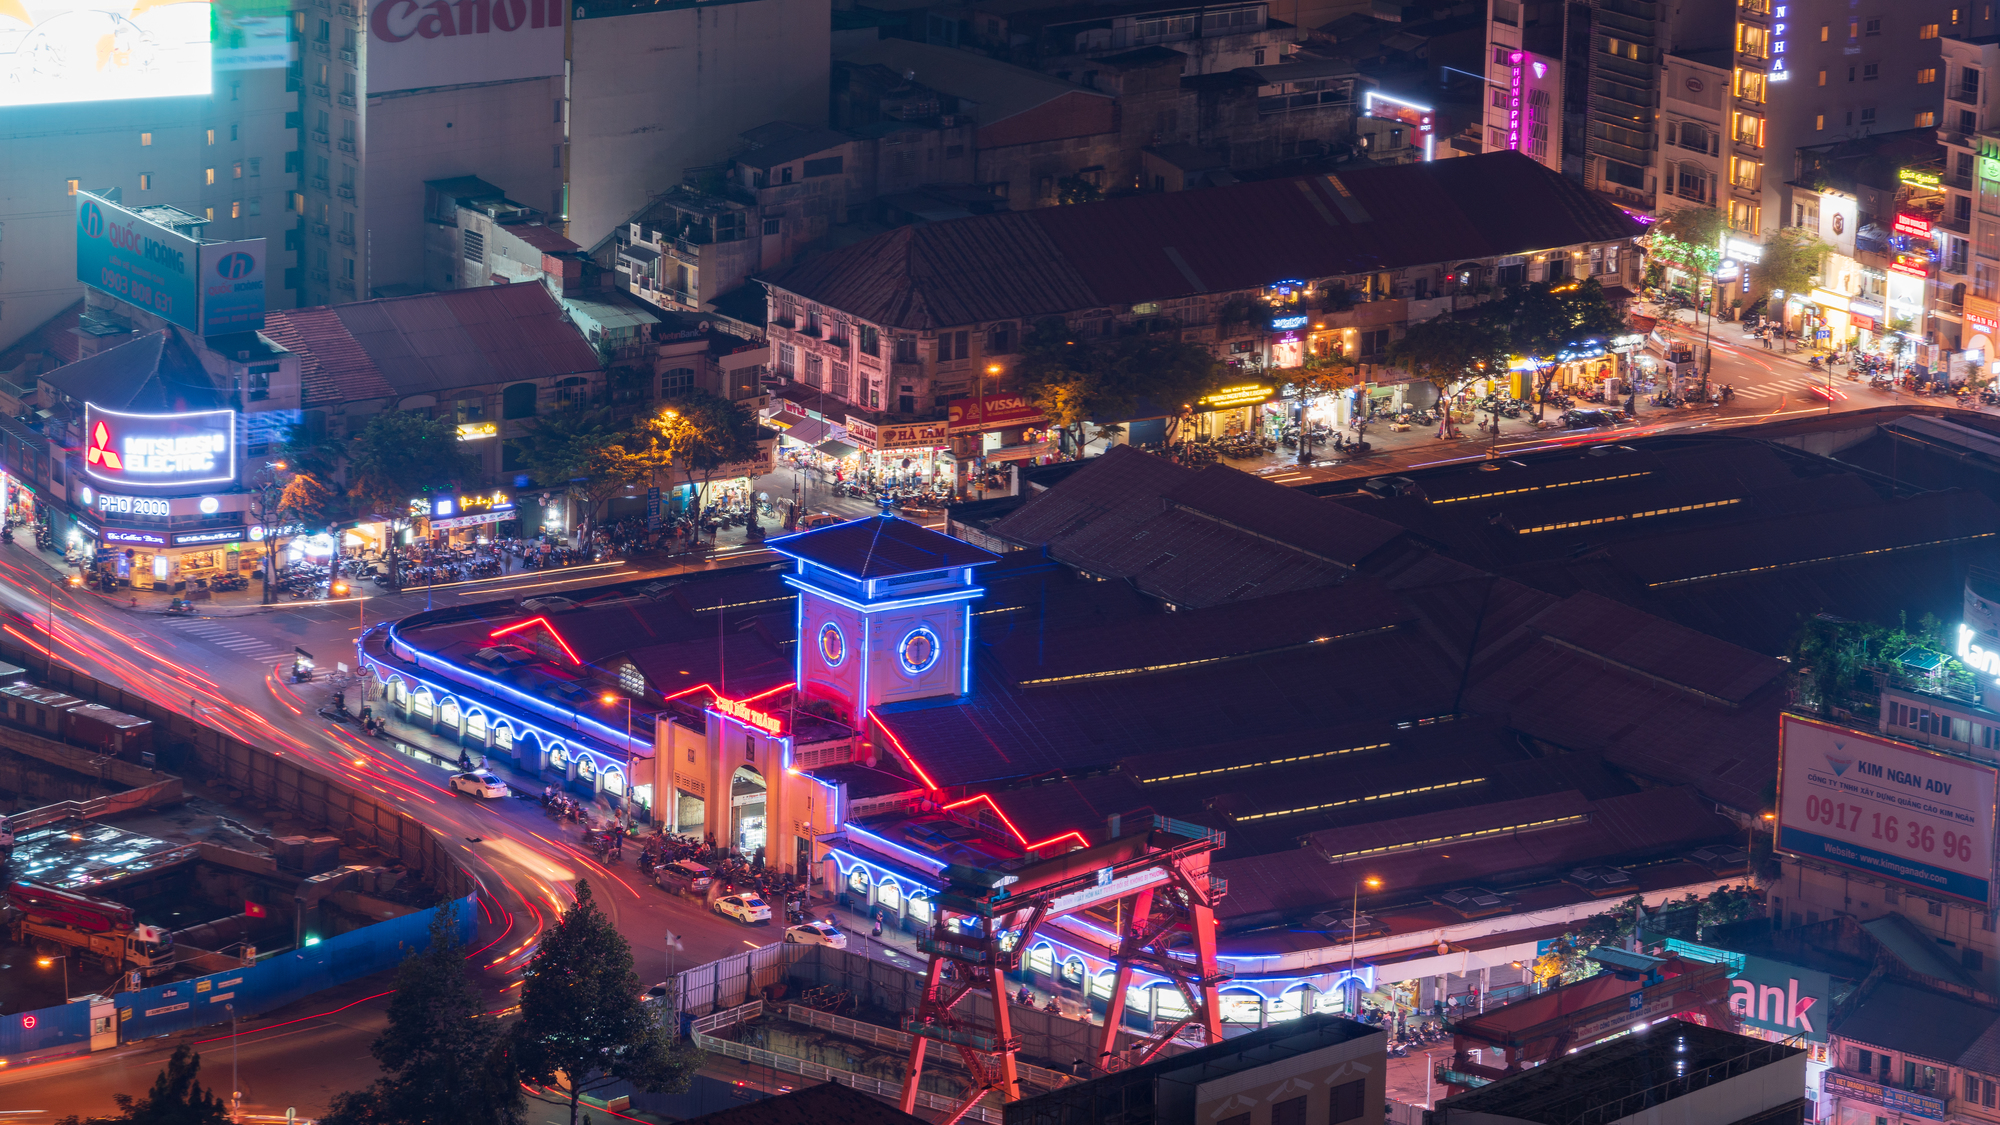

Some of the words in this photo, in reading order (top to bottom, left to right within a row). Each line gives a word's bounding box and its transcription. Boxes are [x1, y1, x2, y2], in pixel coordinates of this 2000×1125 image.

[371, 0, 562, 43] Canon
[108, 221, 142, 256] QUỐC
[144, 237, 184, 274] HOÀNG
[102, 267, 128, 294] 0903
[132, 280, 152, 305] 808
[155, 291, 172, 314] 631
[125, 434, 224, 455] MITSUBISHI
[898, 428, 916, 440] HÀ
[919, 426, 946, 438] TÂM
[125, 453, 214, 472] ELECTRIC
[134, 499, 170, 516] 2000
[1958, 624, 2000, 684] Kan
[1858, 760, 1883, 778] KIM
[1887, 768, 1922, 788] NGAN
[1925, 781, 1952, 796] ADV
[1807, 774, 1827, 784] CÔNG
[1829, 779, 1837, 787] TY
[1839, 781, 1858, 792] TNHH
[1860, 786, 1874, 796] XÂY
[1876, 791, 1896, 803] DỰNG
[1897, 796, 1922, 809] QUẢNG
[1923, 802, 1938, 814] CÁO
[1939, 808, 1954, 818] KIM
[1955, 811, 1975, 823] NGÂN
[1806, 794, 1862, 832] 0917
[1872, 813, 1898, 843] 16
[1906, 821, 1935, 853] 36
[1943, 831, 1972, 862] 96
[1824, 842, 1858, 860] Website:
[1860, 853, 1947, 884] www.kimnganadv.com
[1836, 1078, 1845, 1086] VIET
[1847, 1080, 1865, 1091] DRAGON
[1866, 1085, 1883, 1096] TRAVEL
[1894, 1093, 1906, 1101] VIET
[1908, 1096, 1920, 1105] STAR
[1922, 1100, 1941, 1110] TRAVEL
